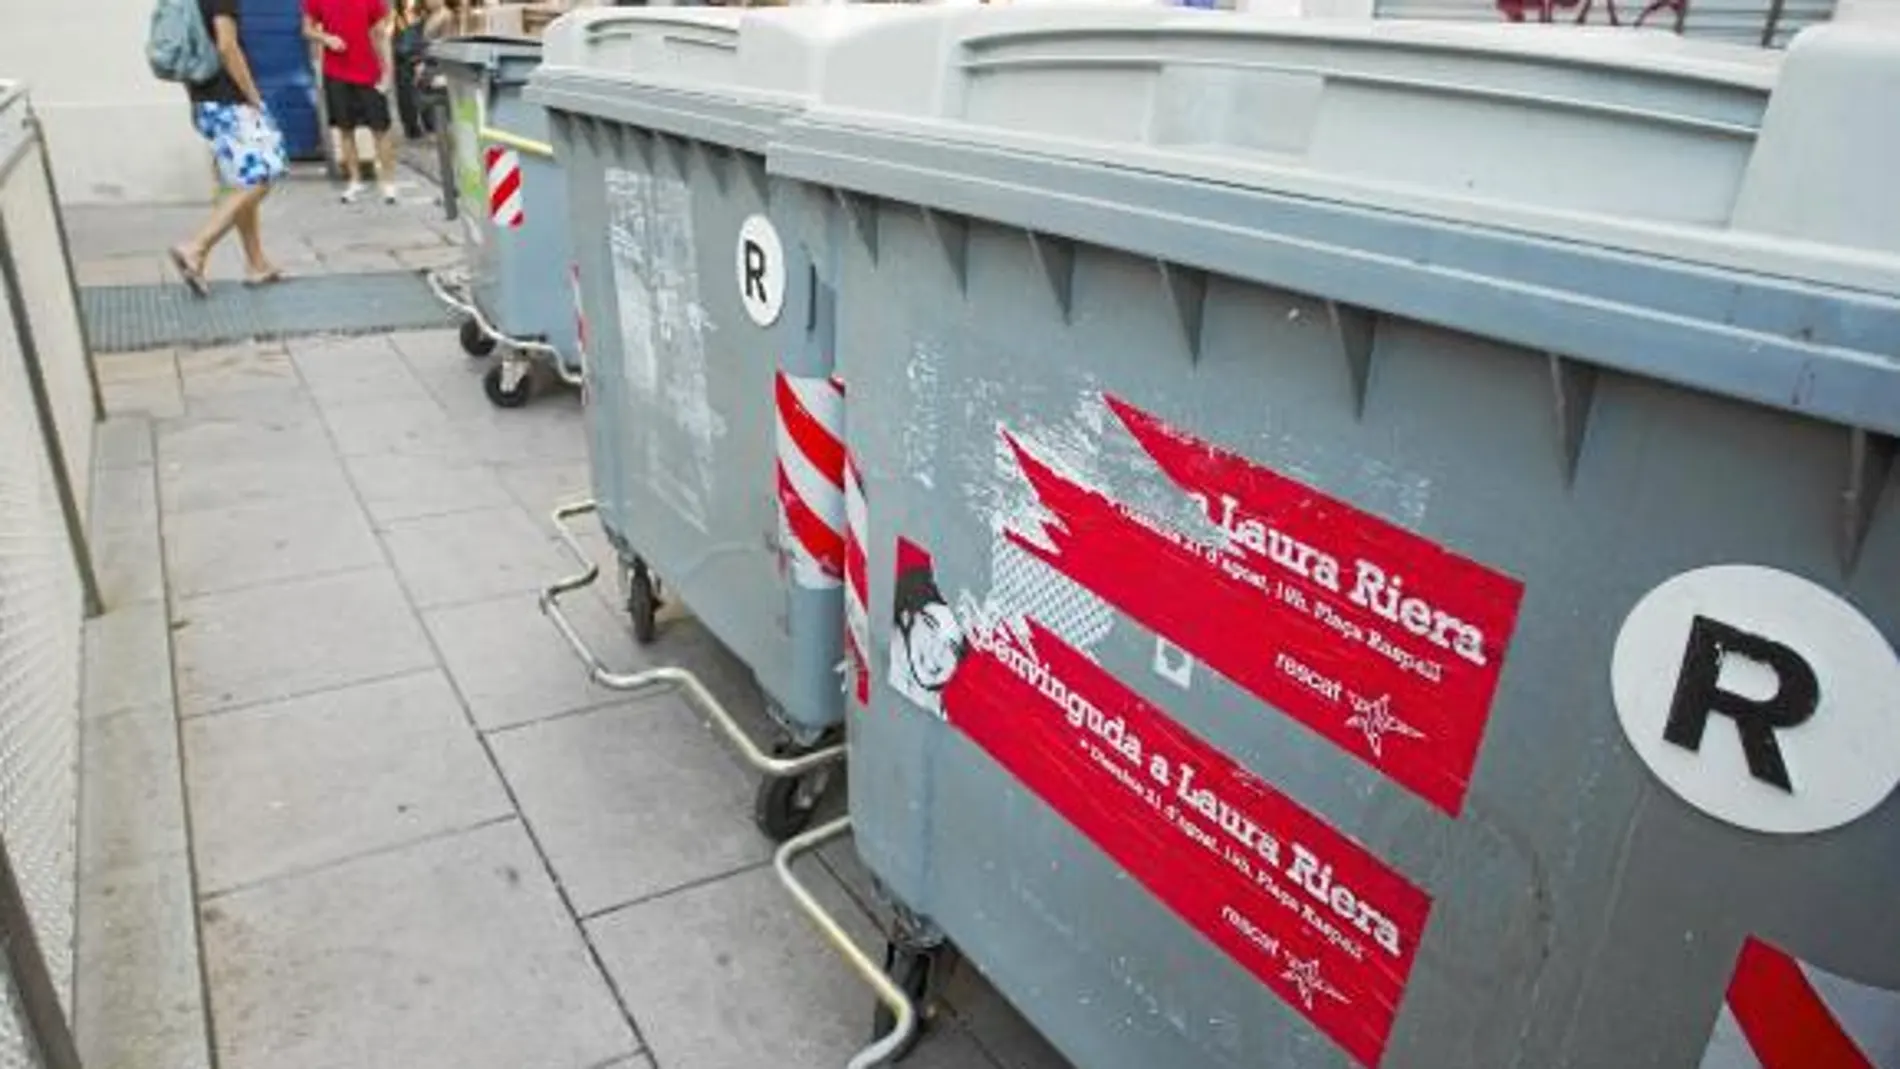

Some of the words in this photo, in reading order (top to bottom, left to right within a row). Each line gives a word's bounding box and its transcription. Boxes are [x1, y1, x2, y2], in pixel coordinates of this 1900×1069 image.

[744, 239, 767, 304] R
[1217, 493, 1340, 592] Laura
[1348, 558, 1488, 668] Riera
[1275, 653, 1342, 702] rescat
[1662, 614, 1821, 796] R
[1149, 753, 1171, 786] a
[1177, 762, 1280, 868] Laura
[1285, 841, 1402, 957] Riera
[1221, 905, 1279, 957] rescat
